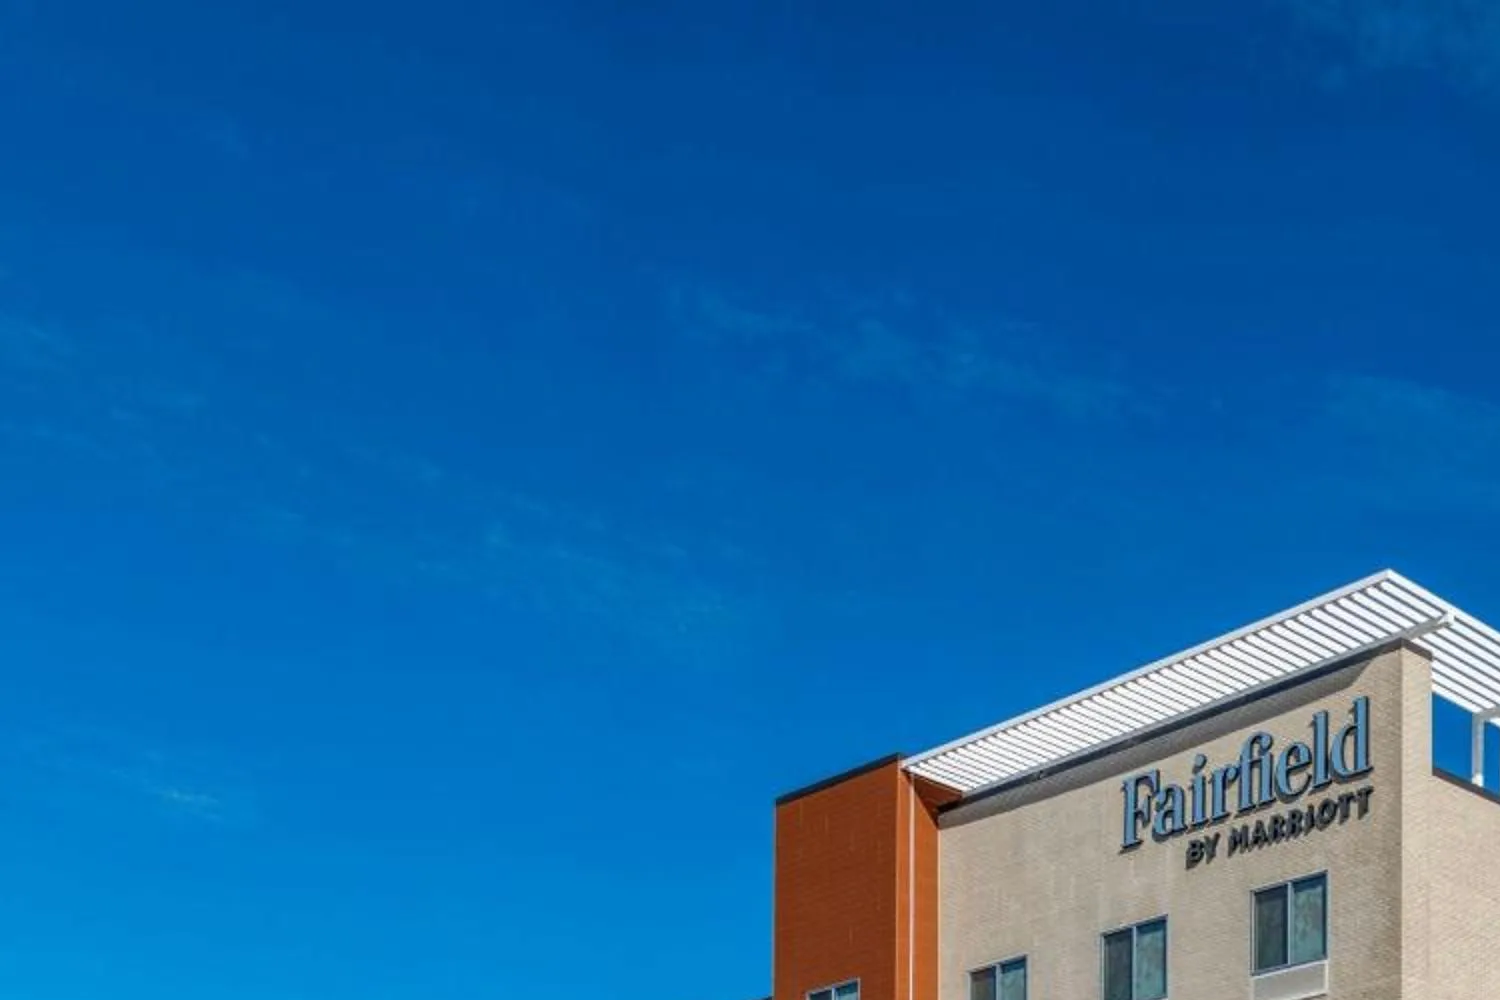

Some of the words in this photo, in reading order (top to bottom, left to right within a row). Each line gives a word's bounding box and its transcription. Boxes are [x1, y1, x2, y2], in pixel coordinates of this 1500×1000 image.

[1120, 695, 1374, 852] Fairfield
[1186, 832, 1221, 869] BY
[1228, 785, 1375, 857] MARRIOTT
